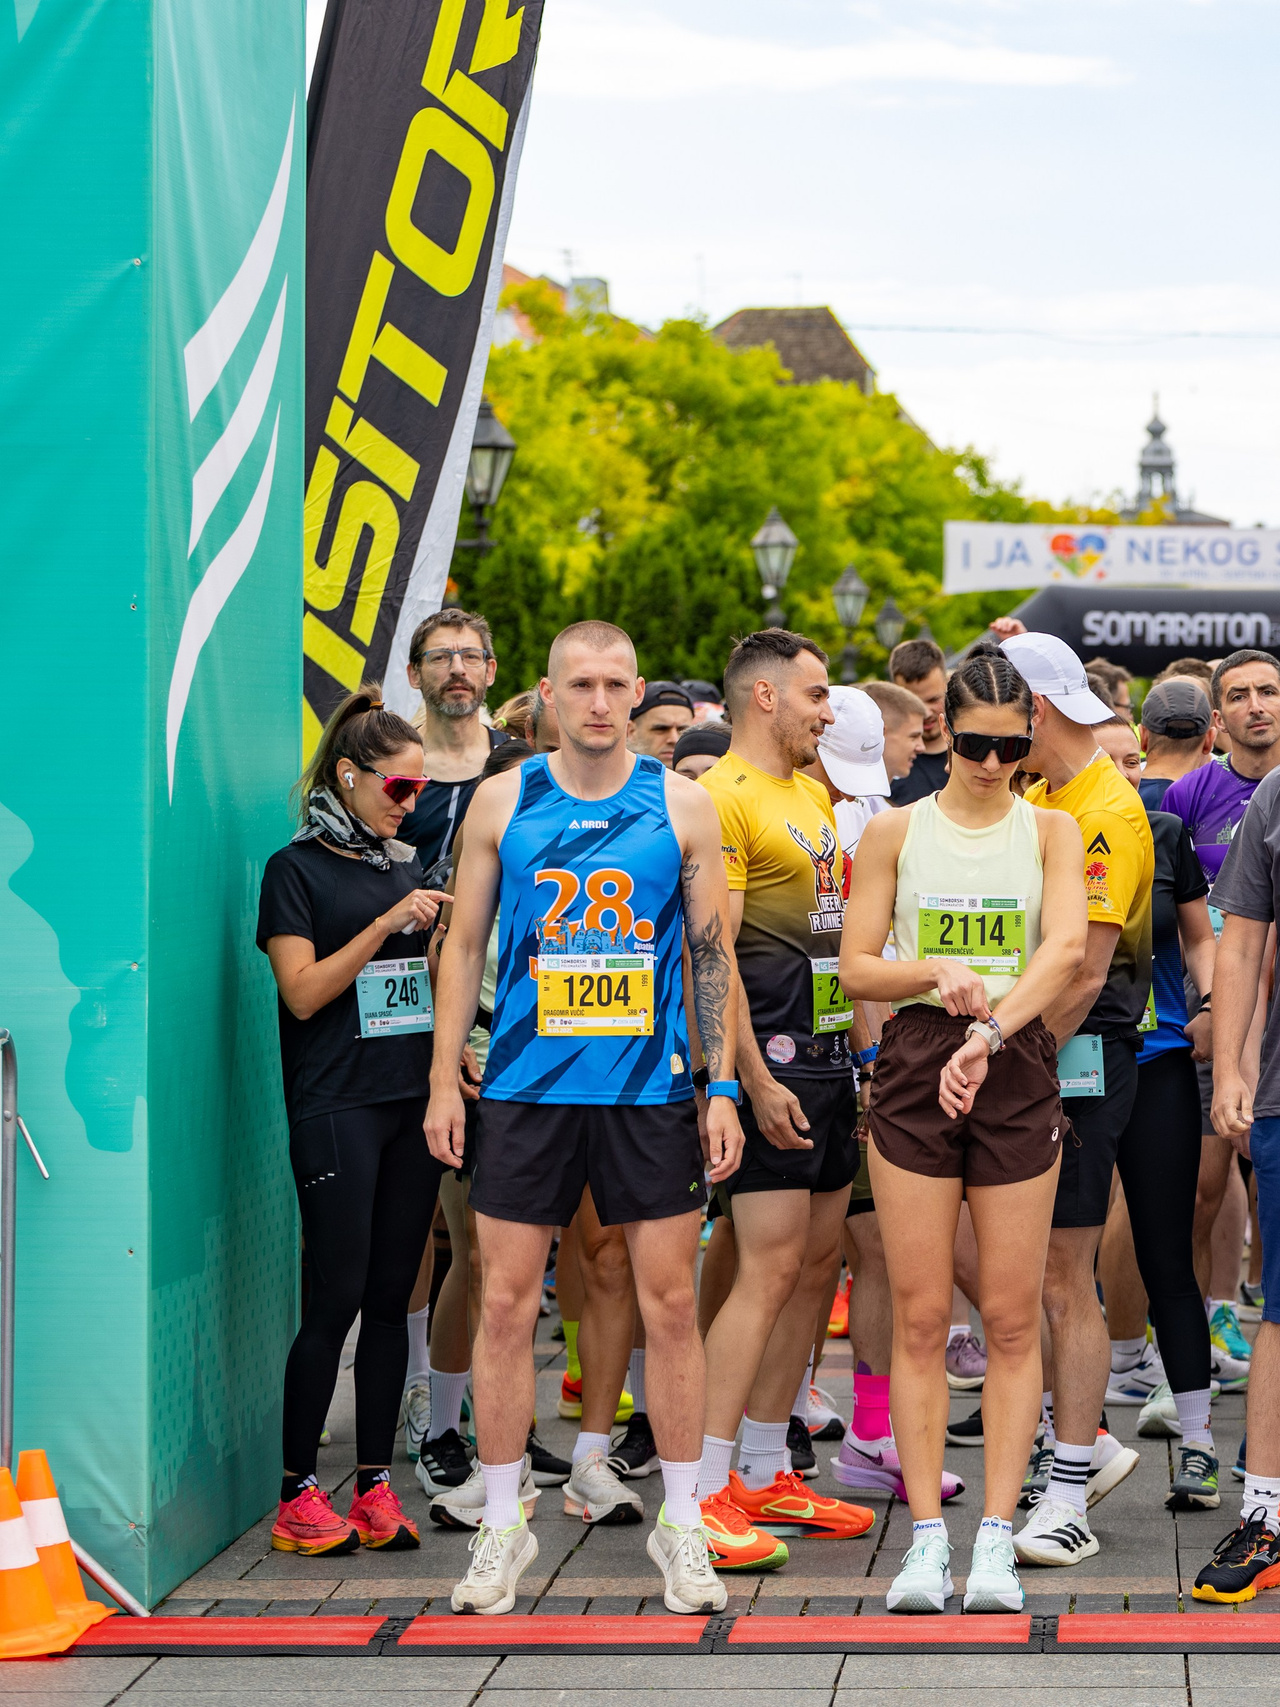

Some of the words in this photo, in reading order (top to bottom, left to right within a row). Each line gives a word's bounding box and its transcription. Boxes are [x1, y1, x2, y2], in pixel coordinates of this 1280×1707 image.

[303, 0, 527, 760] ISITOR
[986, 540, 1032, 569] JA
[1126, 538, 1261, 566] NEKOG
[581, 820, 609, 829] ARDU
[535, 868, 654, 942] 28.
[820, 896, 843, 912] DEER
[810, 913, 844, 932] RUNNE
[939, 913, 1005, 946] 2114
[945, 947, 974, 955] PERENČEVIĆ
[384, 976, 419, 1008] 246
[563, 974, 631, 1007] 1204
[365, 1011, 378, 1019] DIANA
[378, 1009, 393, 1018] SPASIĆ
[570, 1008, 585, 1016] VUČIĆ
[918, 1522, 942, 1530] asics
